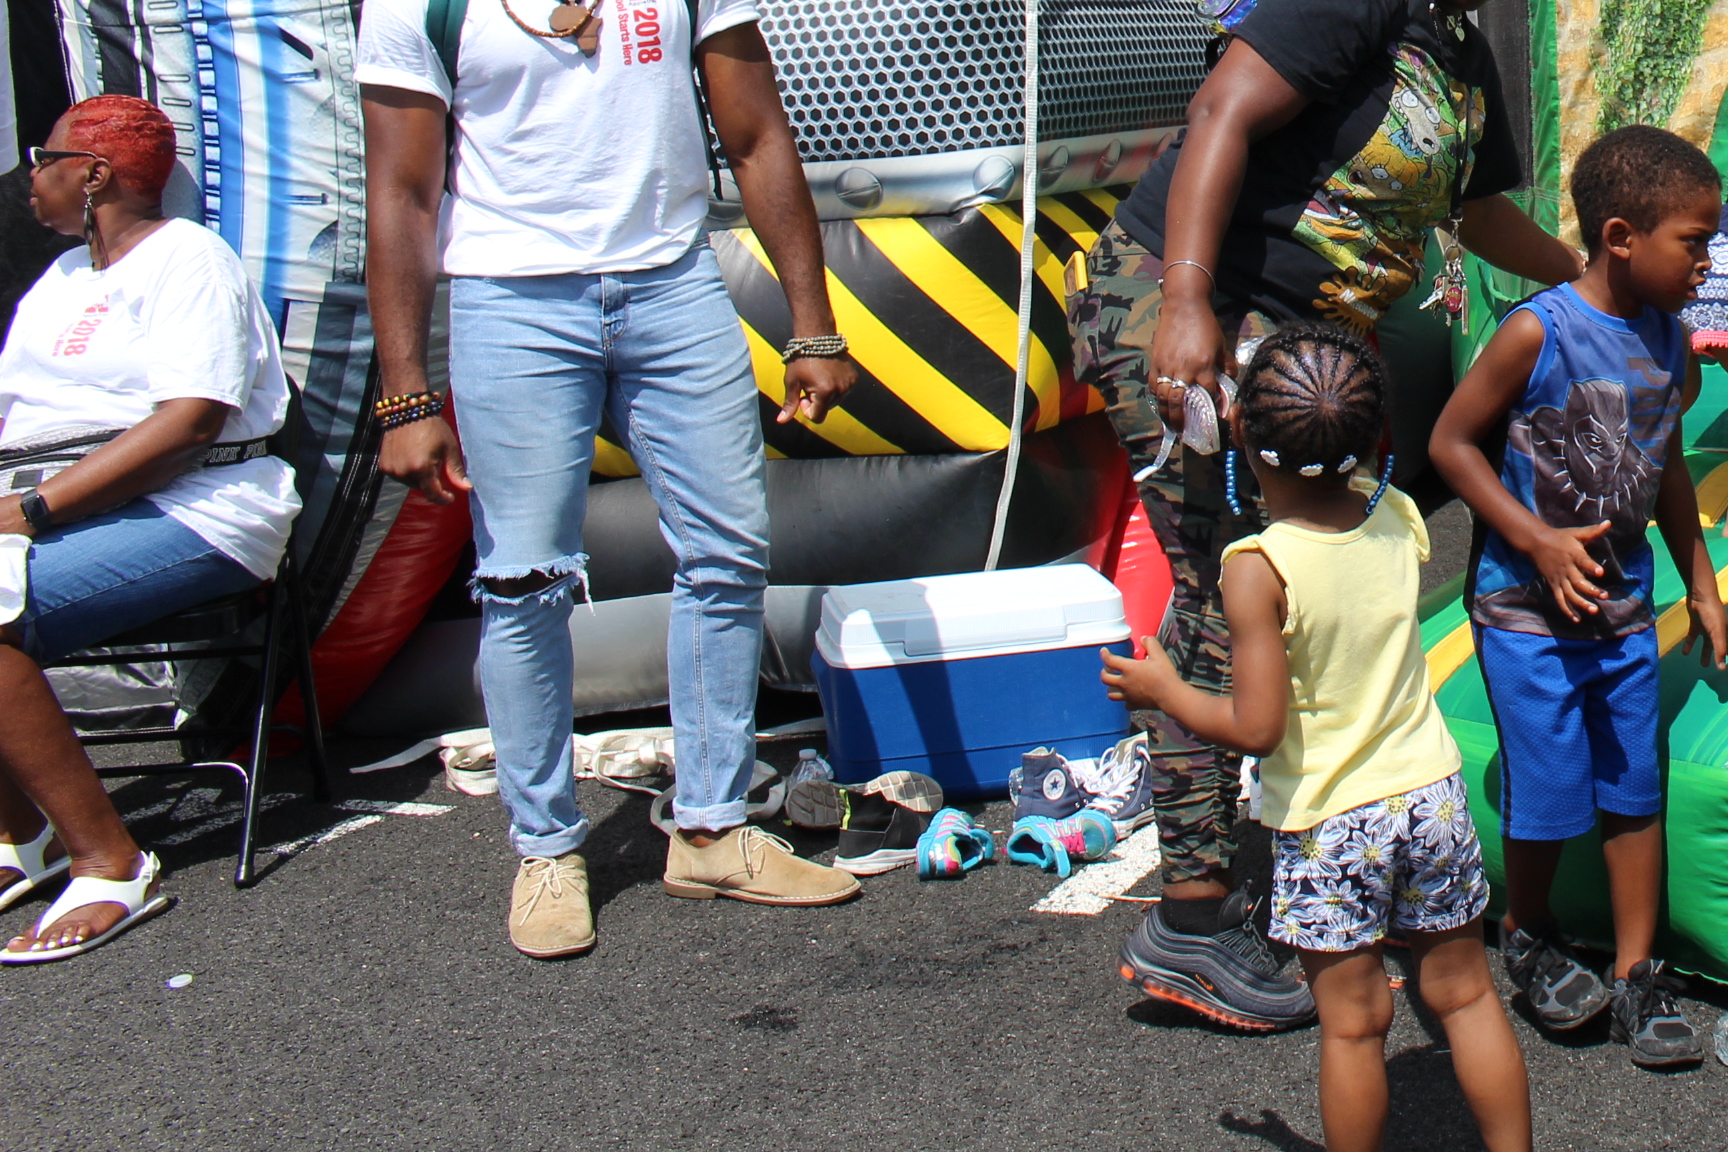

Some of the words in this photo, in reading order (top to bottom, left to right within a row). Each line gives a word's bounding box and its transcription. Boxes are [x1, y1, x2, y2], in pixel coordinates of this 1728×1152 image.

[618, 13, 630, 42] Starts
[633, 7, 662, 64] 2018
[622, 43, 633, 66] Here
[63, 318, 103, 356] 2018
